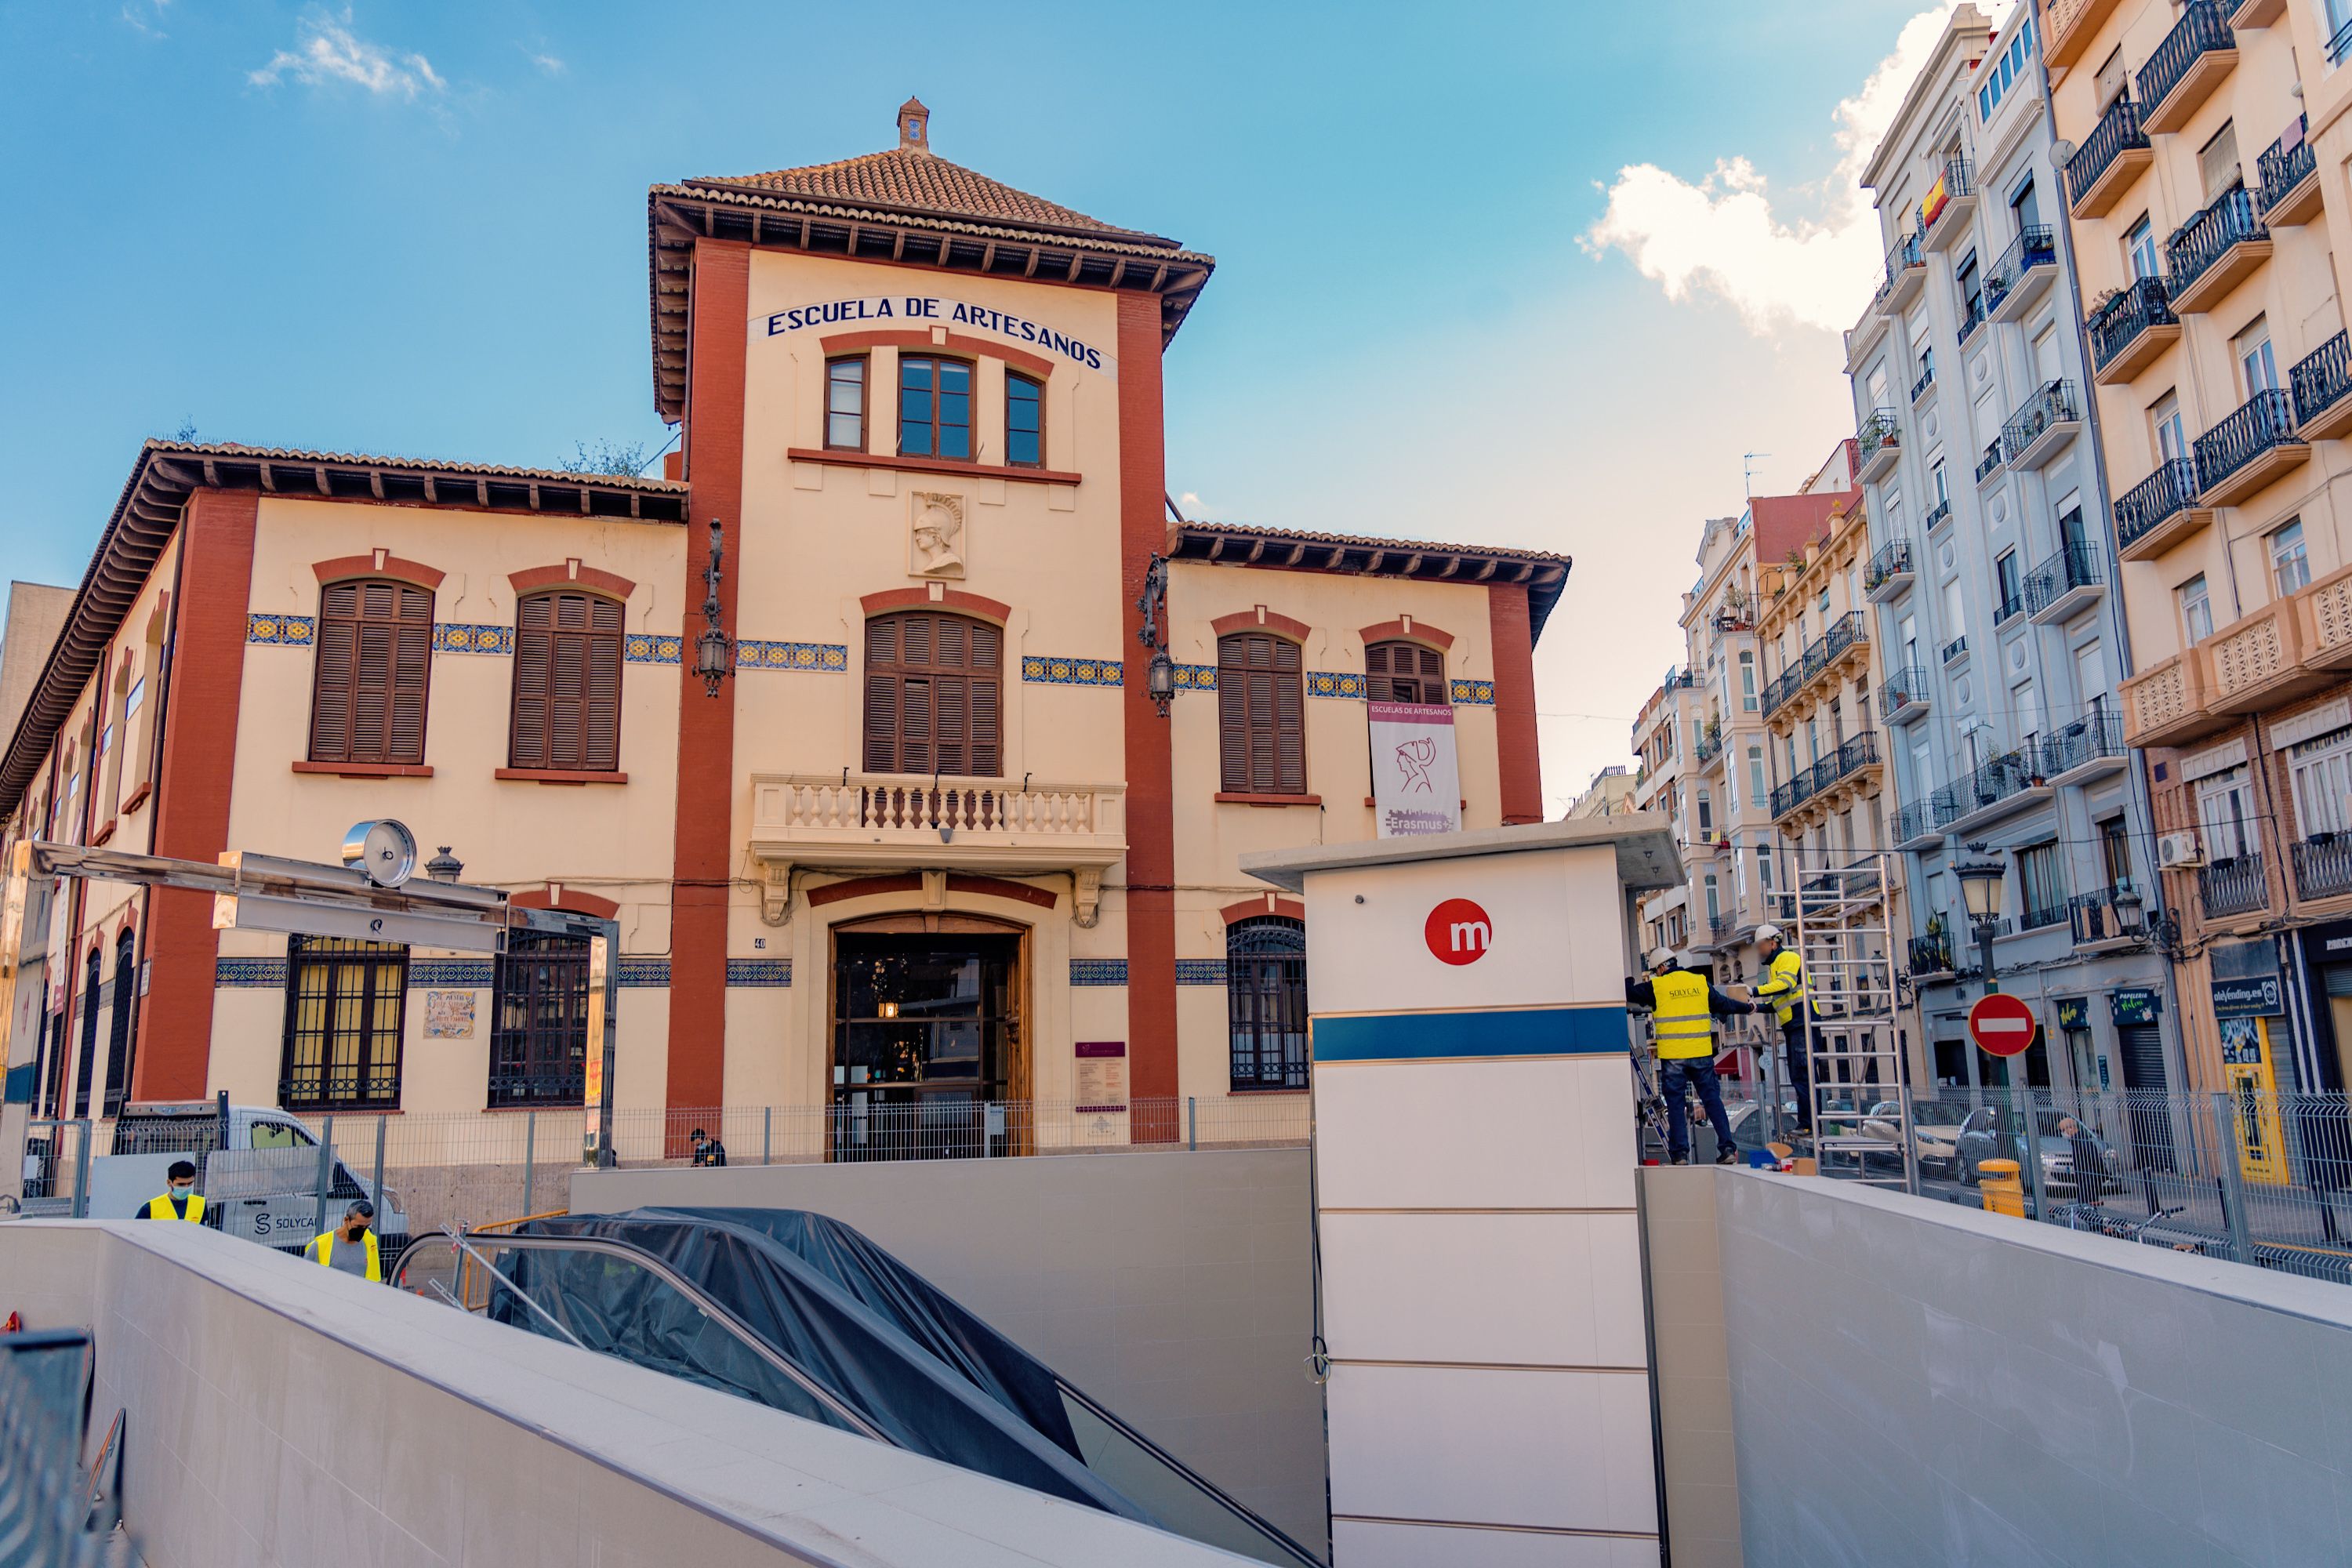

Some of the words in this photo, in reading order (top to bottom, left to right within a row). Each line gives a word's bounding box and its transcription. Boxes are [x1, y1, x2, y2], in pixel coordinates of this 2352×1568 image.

[768, 298, 894, 336] ESCUELA
[906, 297, 940, 318] DE
[952, 302, 1102, 370] ARTESANOS
[1371, 705, 1403, 714] ESCUELAS
[1414, 708, 1452, 717] ARTESANOS
[1391, 816, 1449, 830] Erasmus+
[1450, 921, 1490, 952] m
[755, 939, 765, 949] 40
[1669, 988, 1700, 997] SOLYCAL
